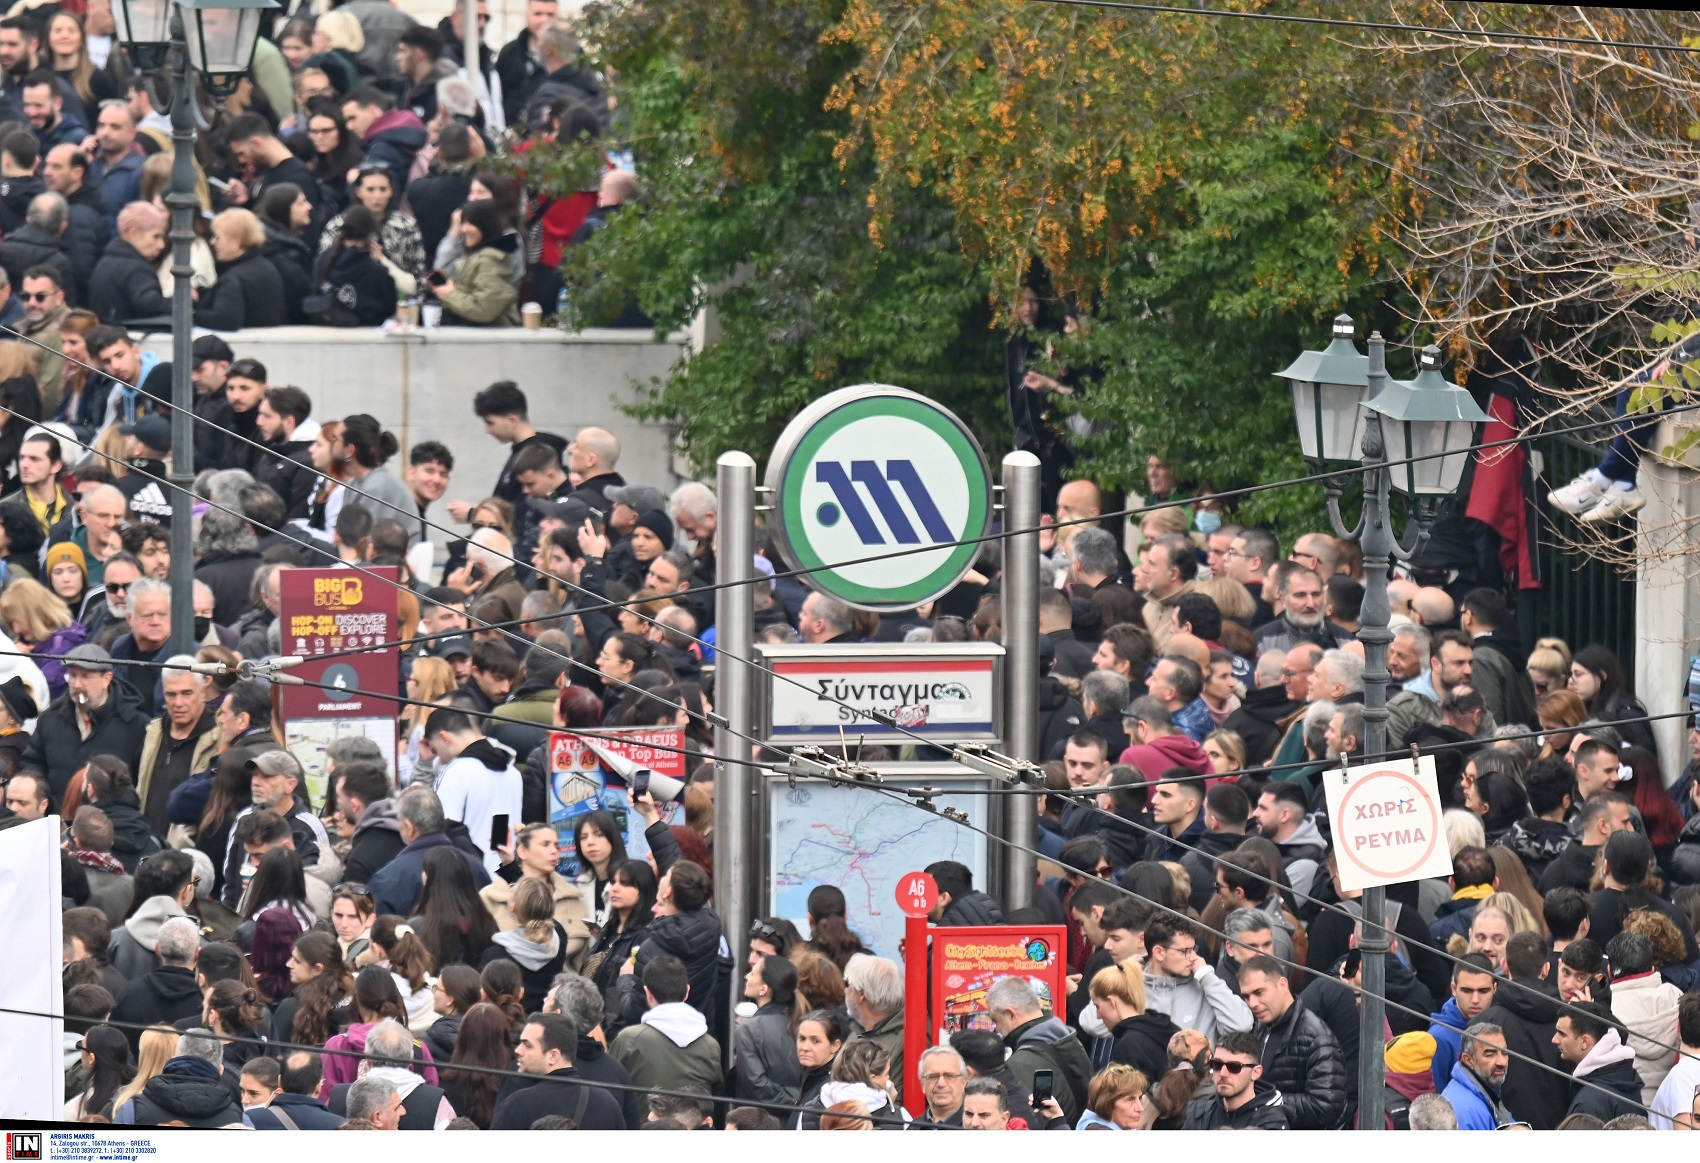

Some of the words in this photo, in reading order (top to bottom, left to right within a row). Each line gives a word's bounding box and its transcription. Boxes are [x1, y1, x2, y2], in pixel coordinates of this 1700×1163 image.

[129, 499, 173, 517] adidas
[314, 578, 341, 593] BIG
[314, 593, 342, 606] BUS
[335, 613, 387, 626] DISCOVER
[292, 625, 339, 636] HOP-OFF
[339, 624, 388, 635] EXPLORE
[333, 673, 347, 692] 6
[557, 755, 572, 767] A6
[581, 755, 595, 766] A9
[629, 748, 652, 762] Top
[1355, 798, 1417, 820] ΧΩΡΙΣ
[1354, 828, 1426, 850] ΡΕΥΜΑ
[909, 879, 925, 896] A6
